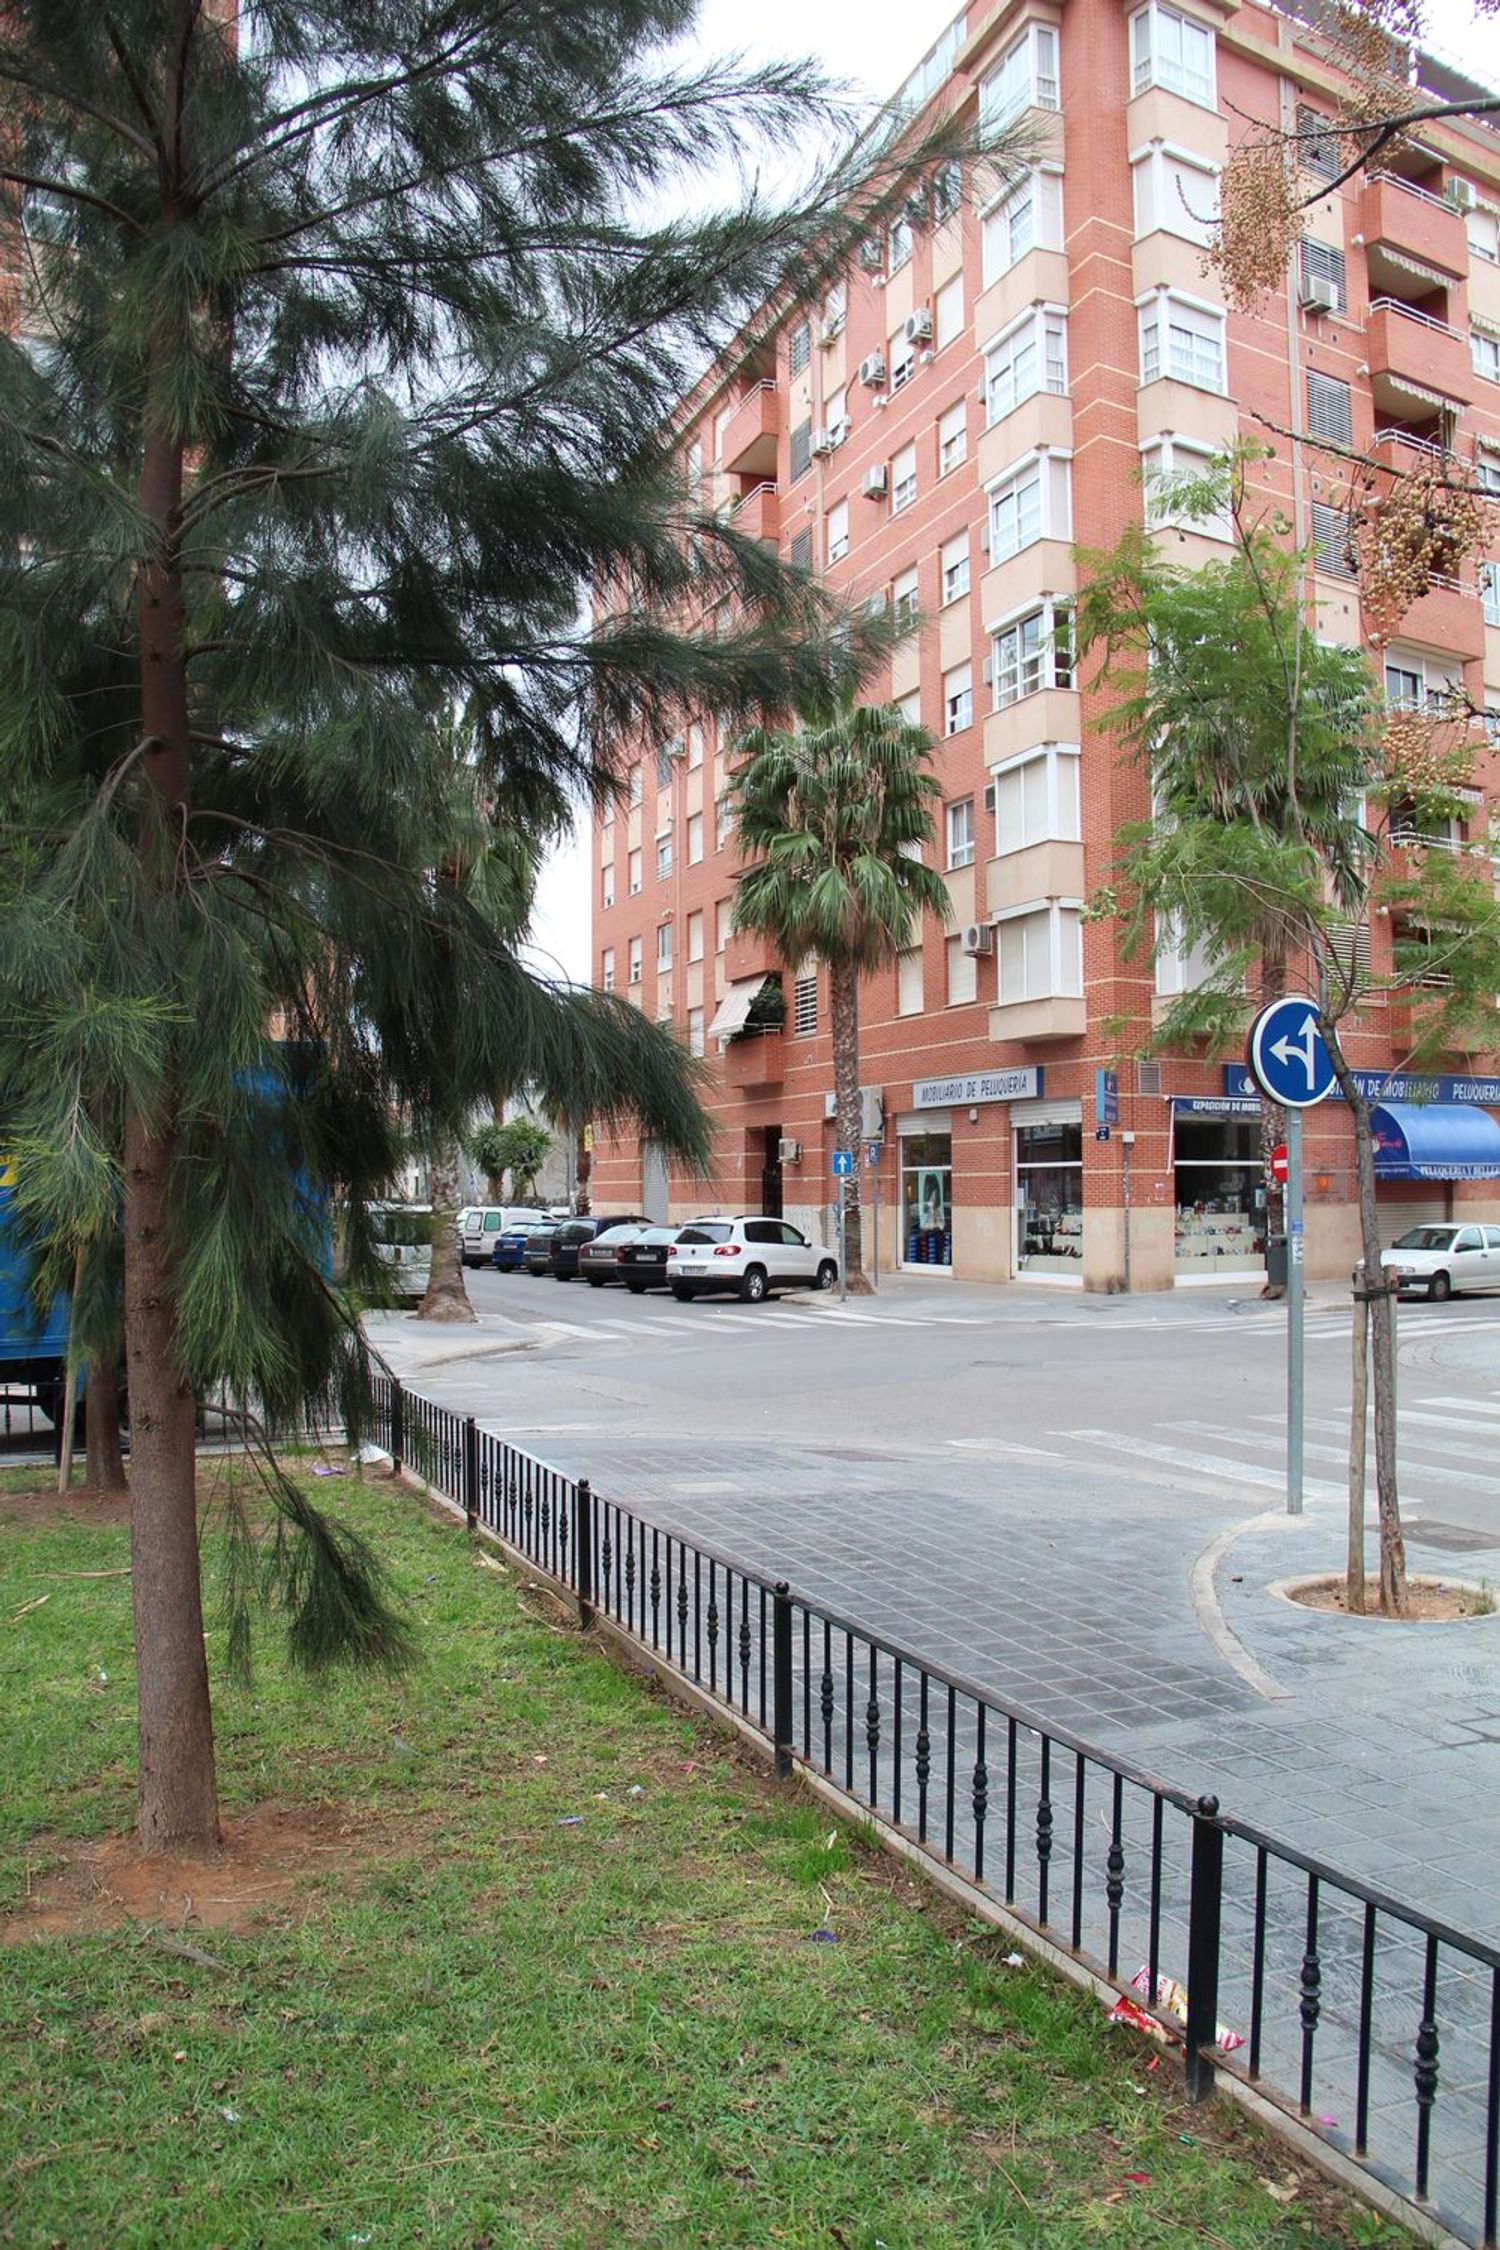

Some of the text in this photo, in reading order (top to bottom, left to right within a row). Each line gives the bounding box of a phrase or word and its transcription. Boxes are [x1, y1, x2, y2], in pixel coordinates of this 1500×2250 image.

[921, 1082, 963, 1103] MOBILIARIO
[966, 1081, 977, 1098] DE
[1367, 1079, 1380, 1097] DE
